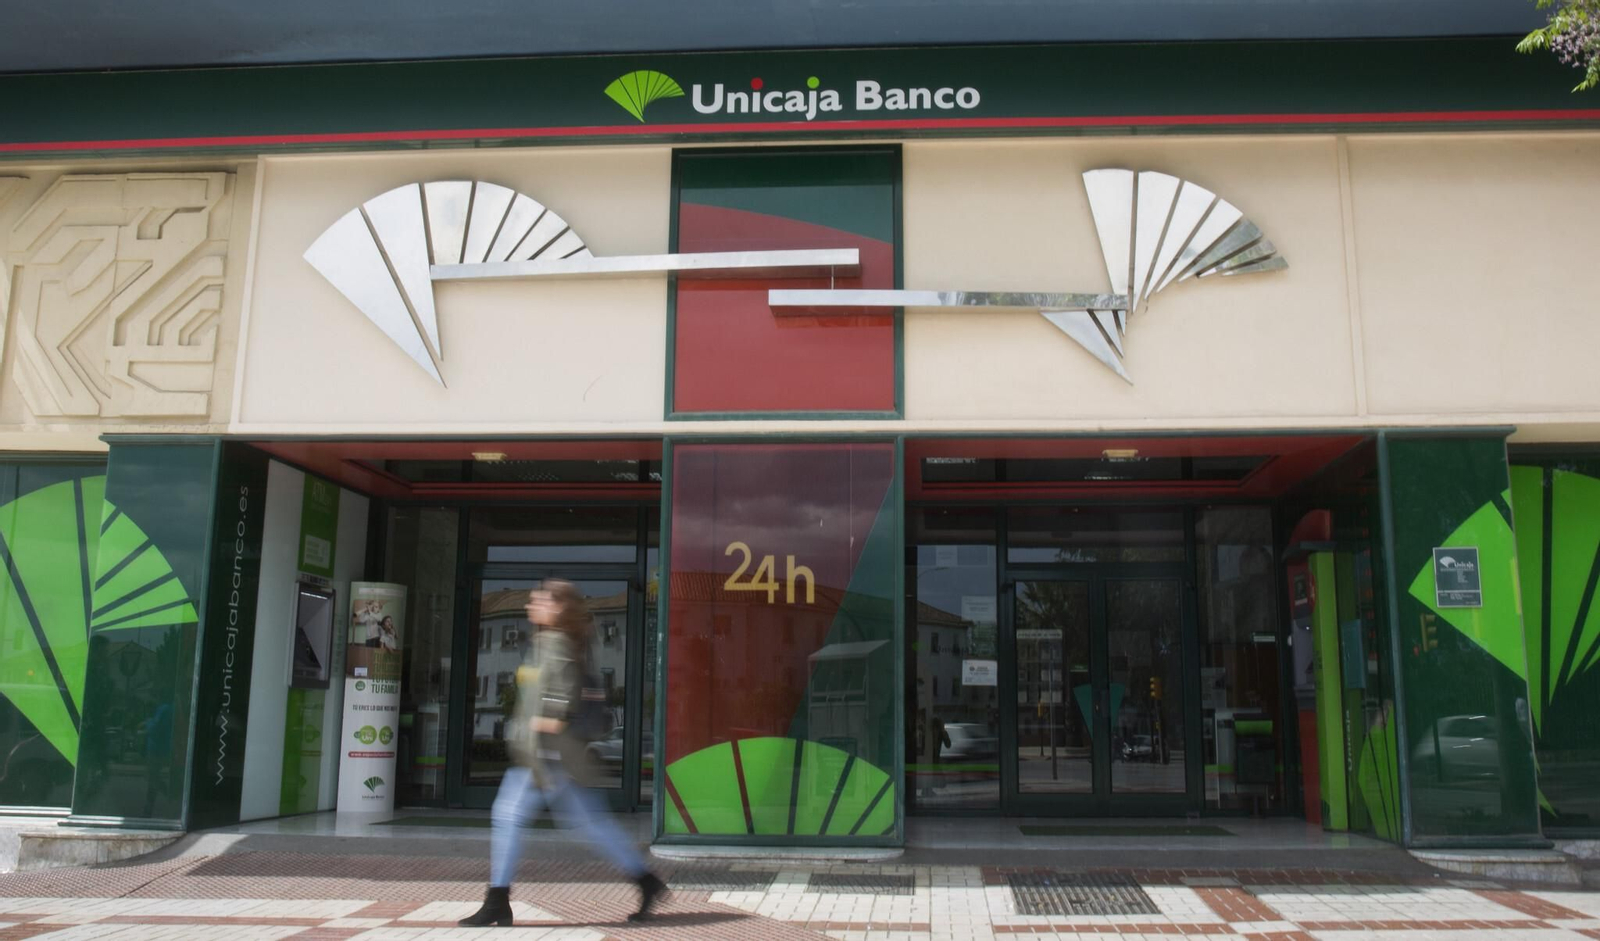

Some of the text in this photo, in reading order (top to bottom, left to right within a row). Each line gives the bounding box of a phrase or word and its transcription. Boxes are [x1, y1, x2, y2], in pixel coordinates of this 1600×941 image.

[692, 77, 981, 121] Unicaja Banco
[724, 541, 815, 604] 24h
[215, 485, 249, 786] www.unicajabanco.es
